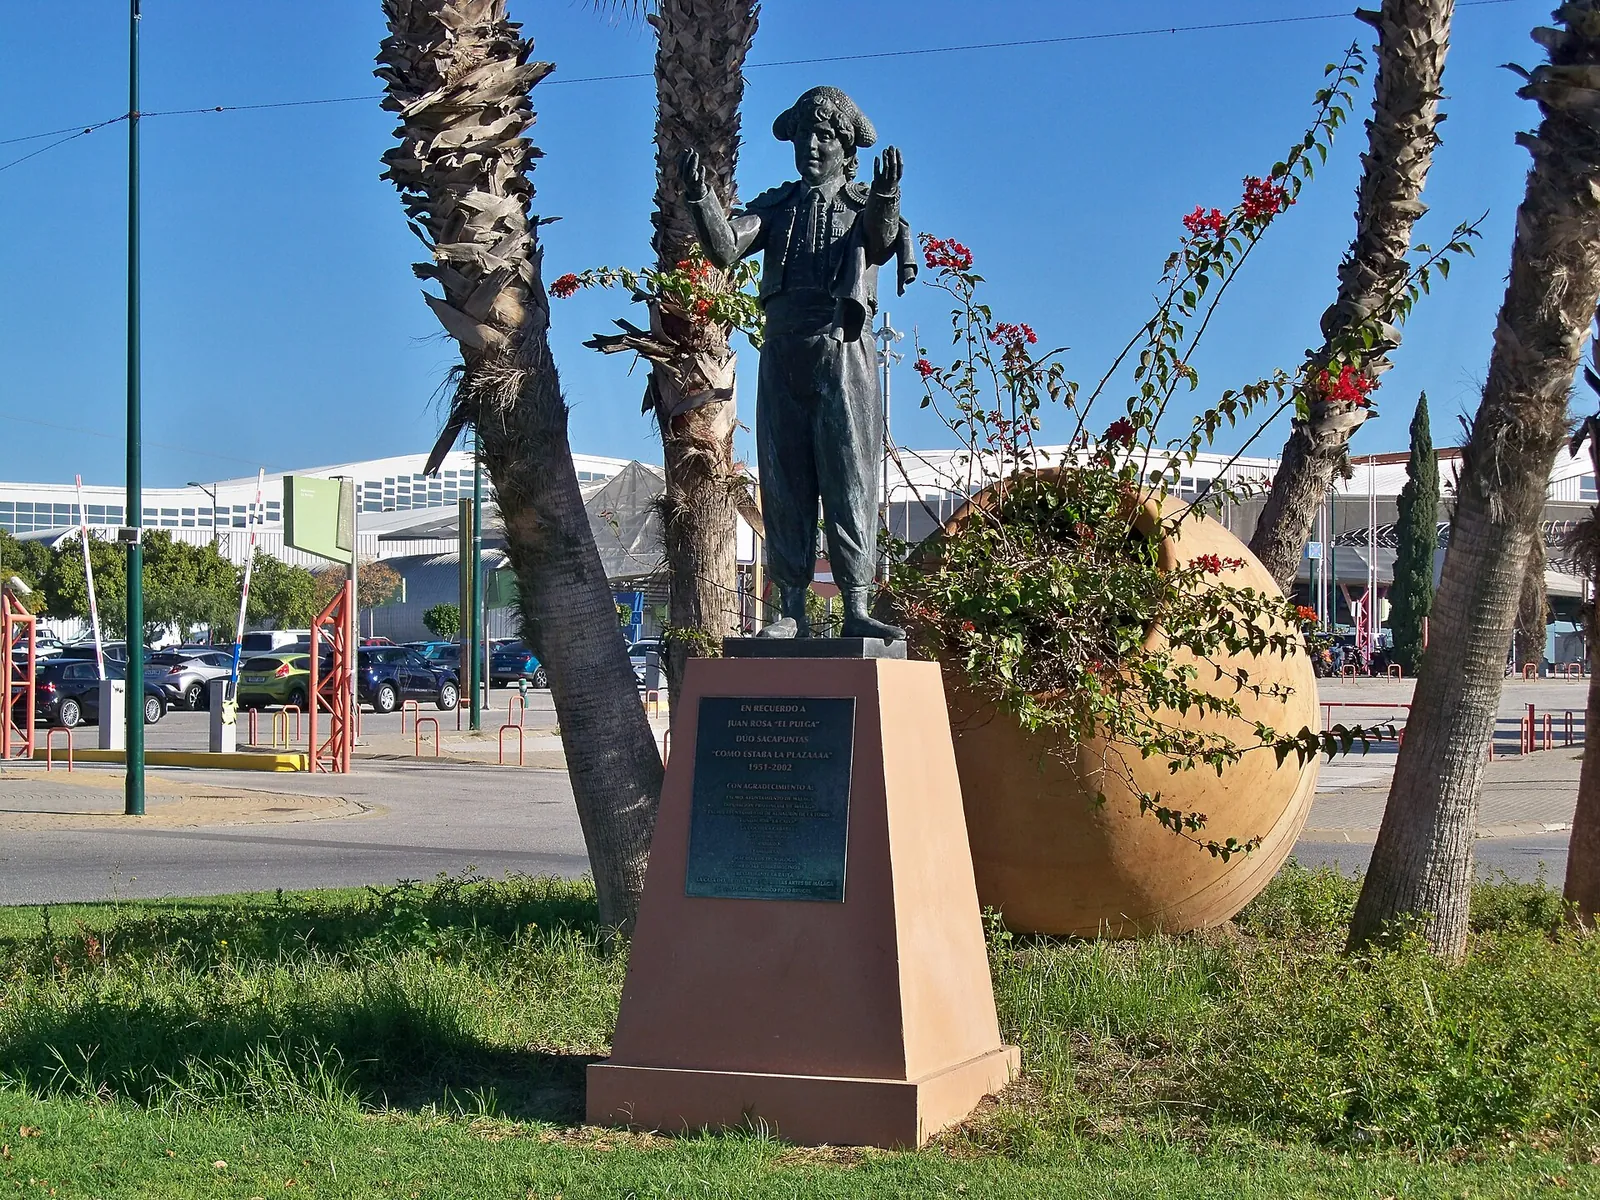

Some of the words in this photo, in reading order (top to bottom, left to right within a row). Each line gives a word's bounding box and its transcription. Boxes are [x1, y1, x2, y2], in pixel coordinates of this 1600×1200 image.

[740, 704, 753, 713] EN
[753, 705, 799, 713] RECUERDO
[799, 705, 807, 713] A
[727, 719, 749, 728] JUAN
[750, 720, 772, 728] ROSA
[756, 735, 809, 743] SACAPUNTAS
[742, 751, 772, 759] ESTABA
[774, 751, 785, 759] LA
[748, 763, 793, 772] 1951-2002
[726, 782, 743, 790] CON
[743, 783, 806, 791] AGRADECIMIENTO
